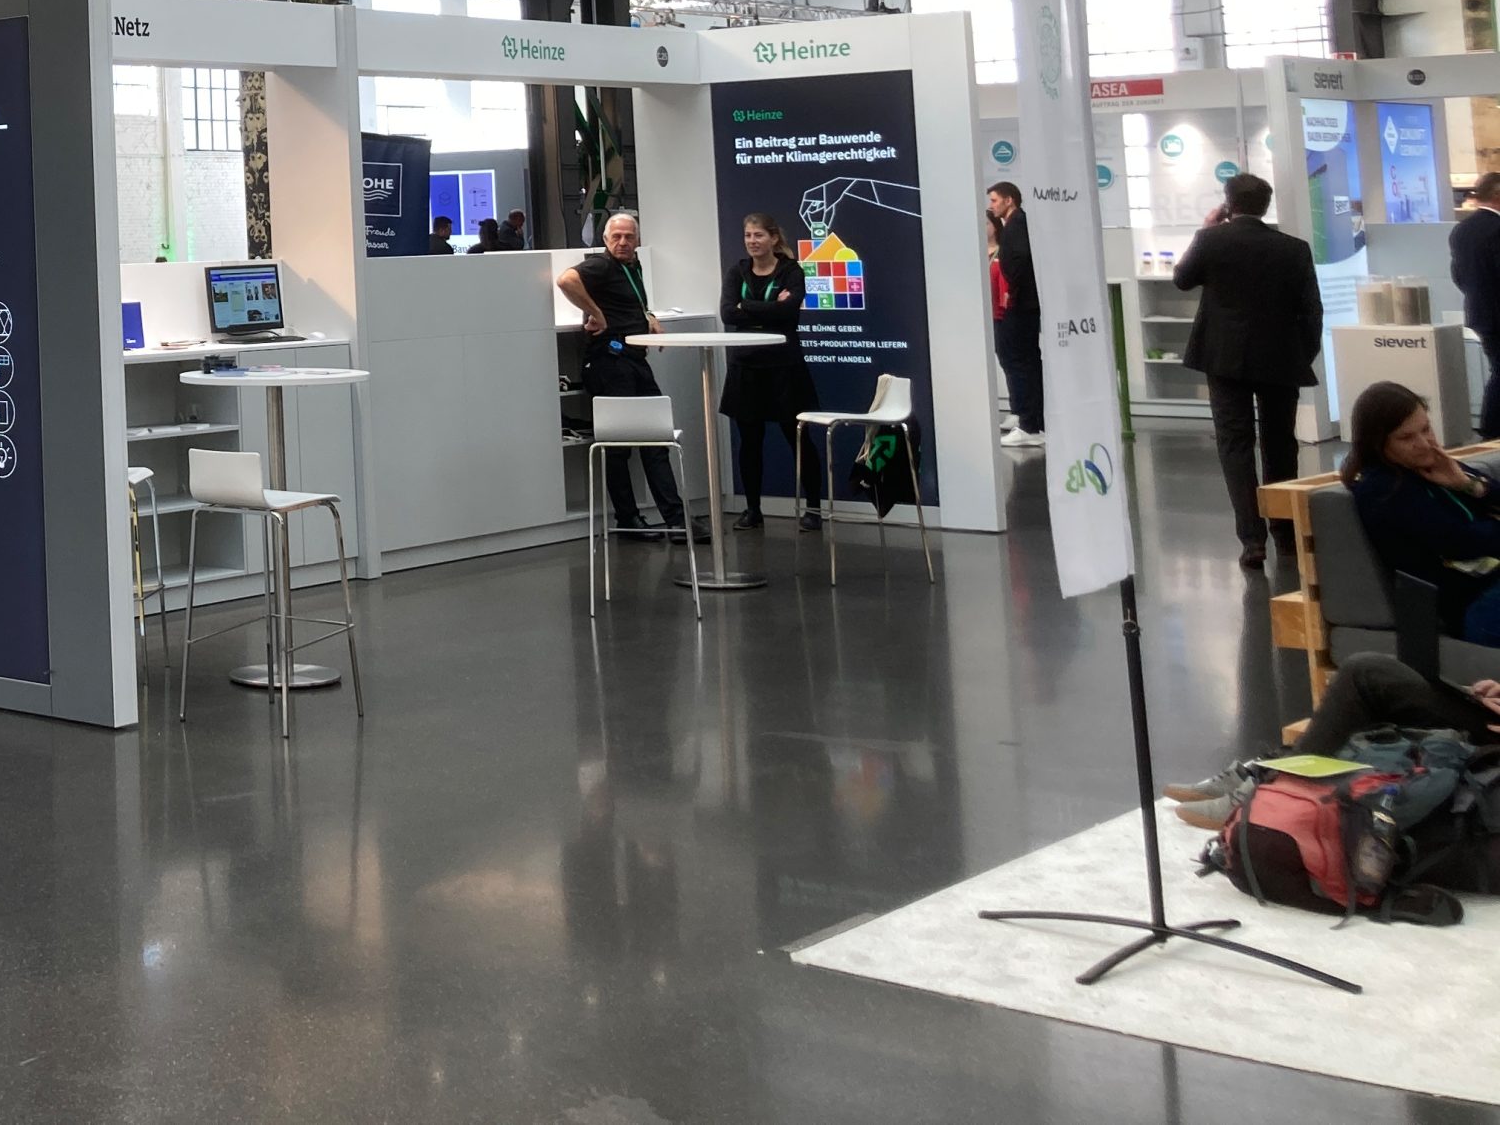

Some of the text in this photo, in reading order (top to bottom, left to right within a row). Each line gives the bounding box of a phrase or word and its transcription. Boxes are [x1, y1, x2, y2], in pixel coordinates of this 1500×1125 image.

[111, 16, 150, 37] Netz
[520, 38, 565, 61] Heinze
[781, 39, 851, 61] Heinze
[747, 109, 783, 122] Heinze
[735, 131, 882, 150] Ein Beitrag zur Bauwende
[736, 147, 897, 165] für mehr Klimagerechtigkeit
[800, 340, 876, 349] EITS-PRODUKTDATEN
[1374, 335, 1427, 349] sievert
